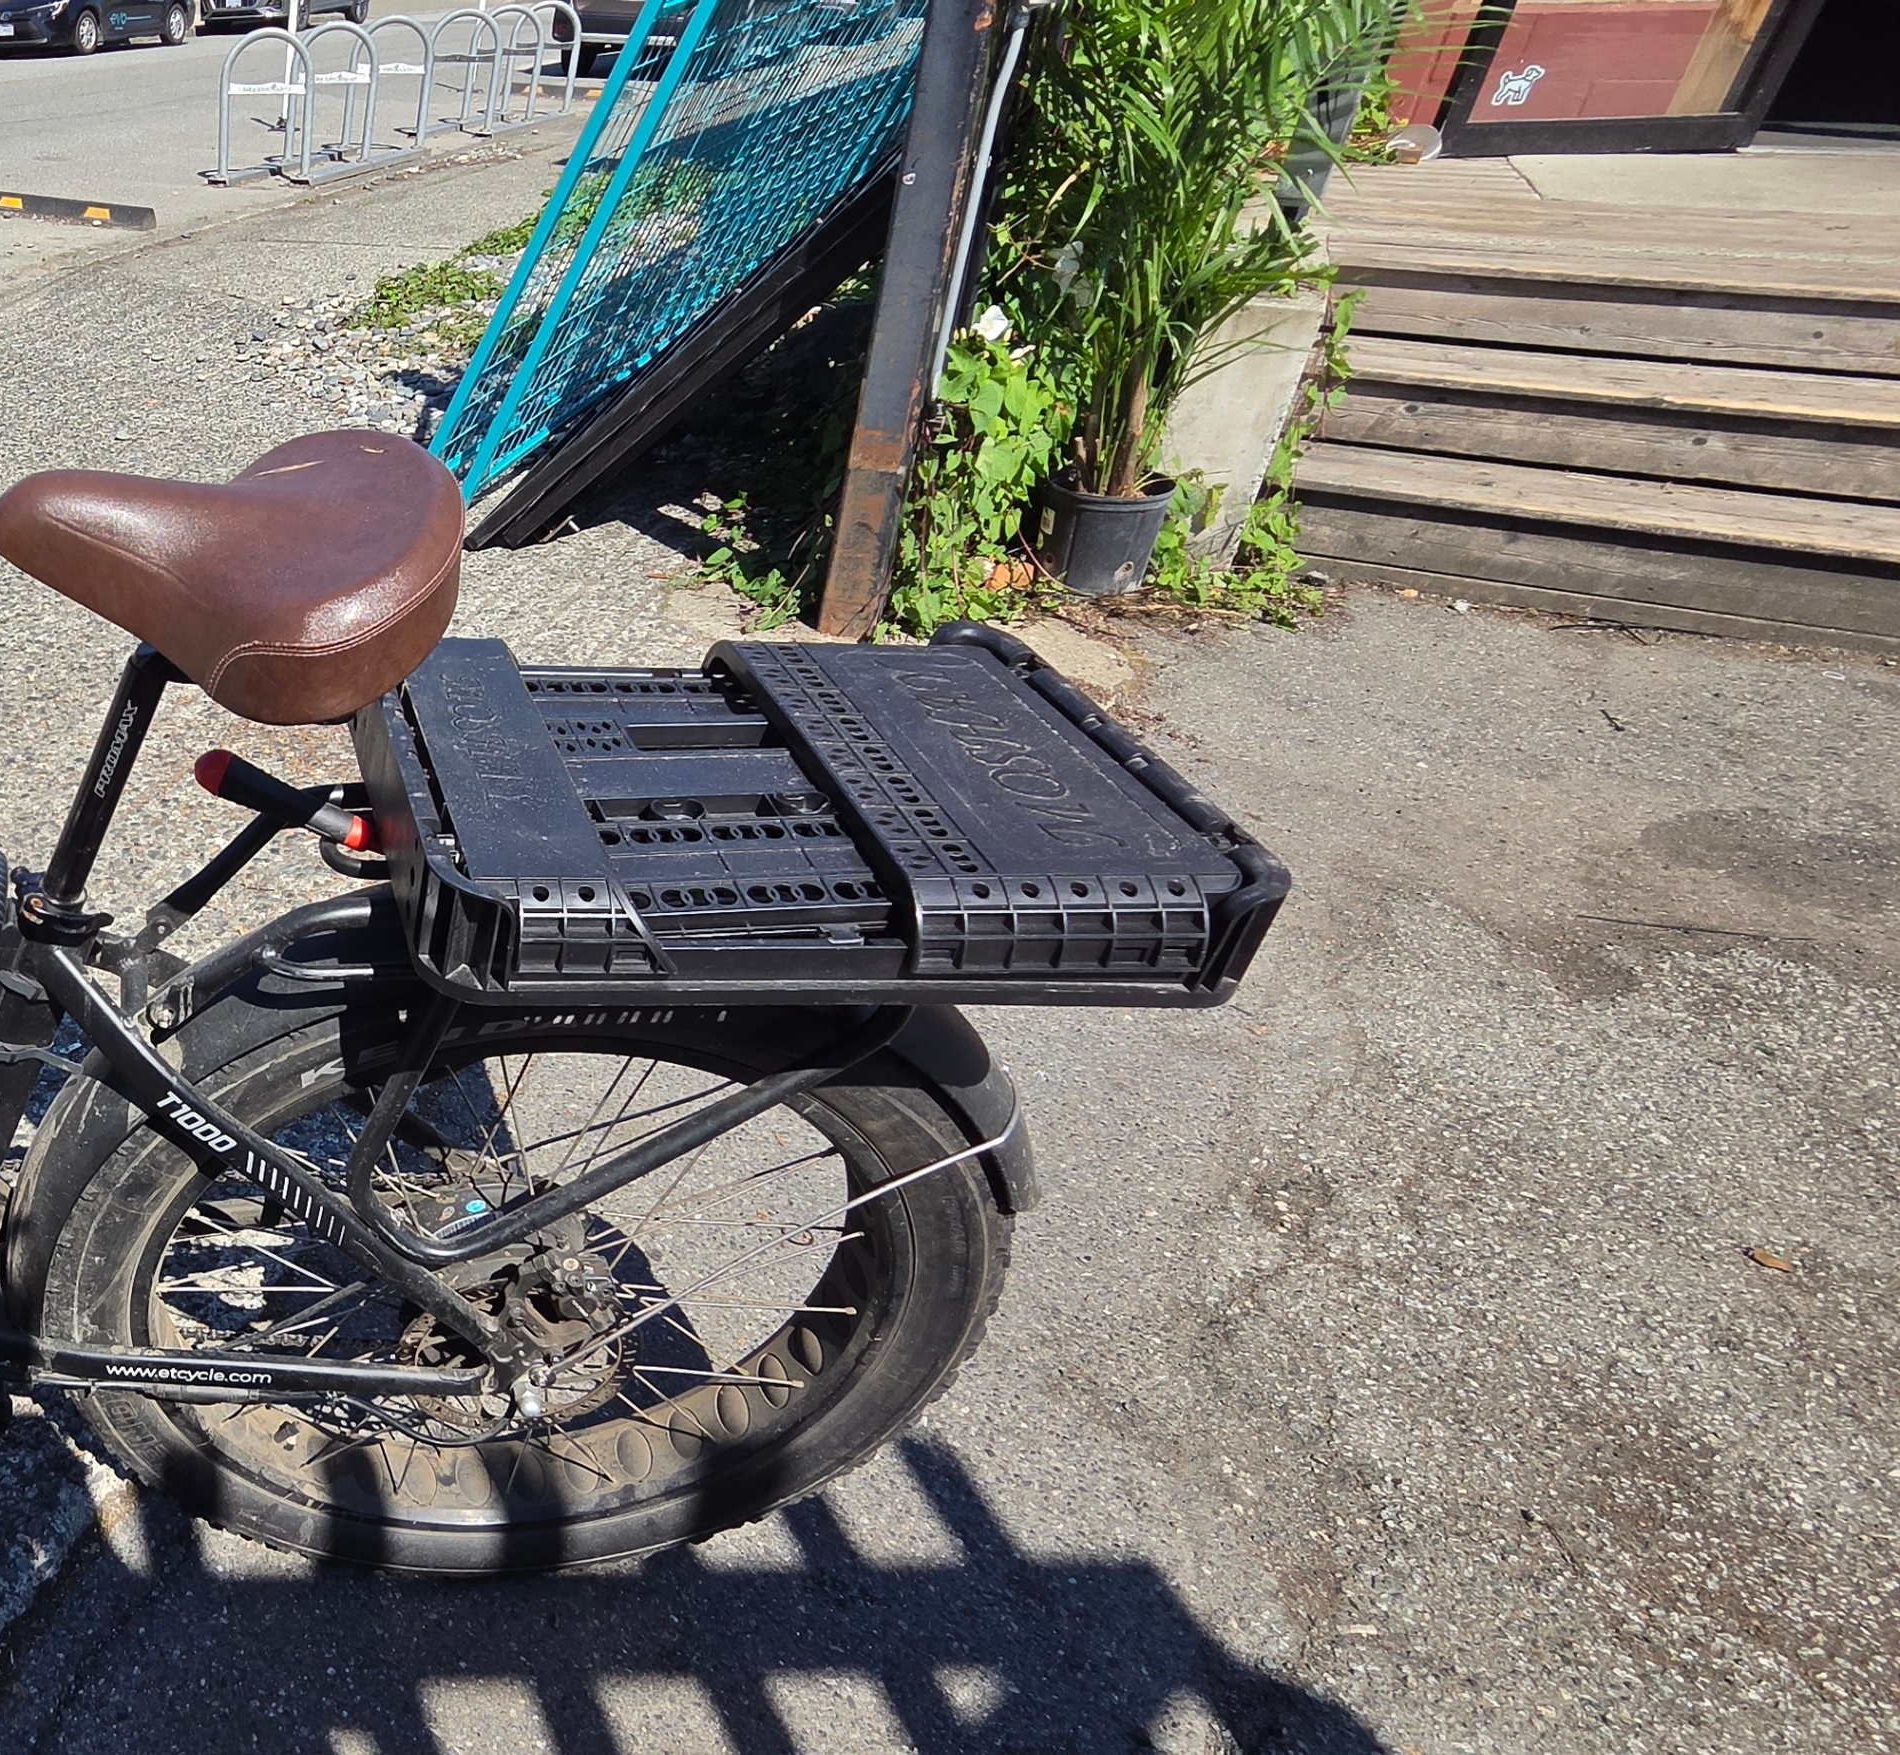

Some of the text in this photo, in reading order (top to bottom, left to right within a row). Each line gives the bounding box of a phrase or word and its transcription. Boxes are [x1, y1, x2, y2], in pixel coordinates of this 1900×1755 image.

[109, 11, 128, 26] evo
[93, 699, 139, 799] PROMAX
[156, 1090, 238, 1154] T1000
[105, 1364, 273, 1385] www.etcycle.com
